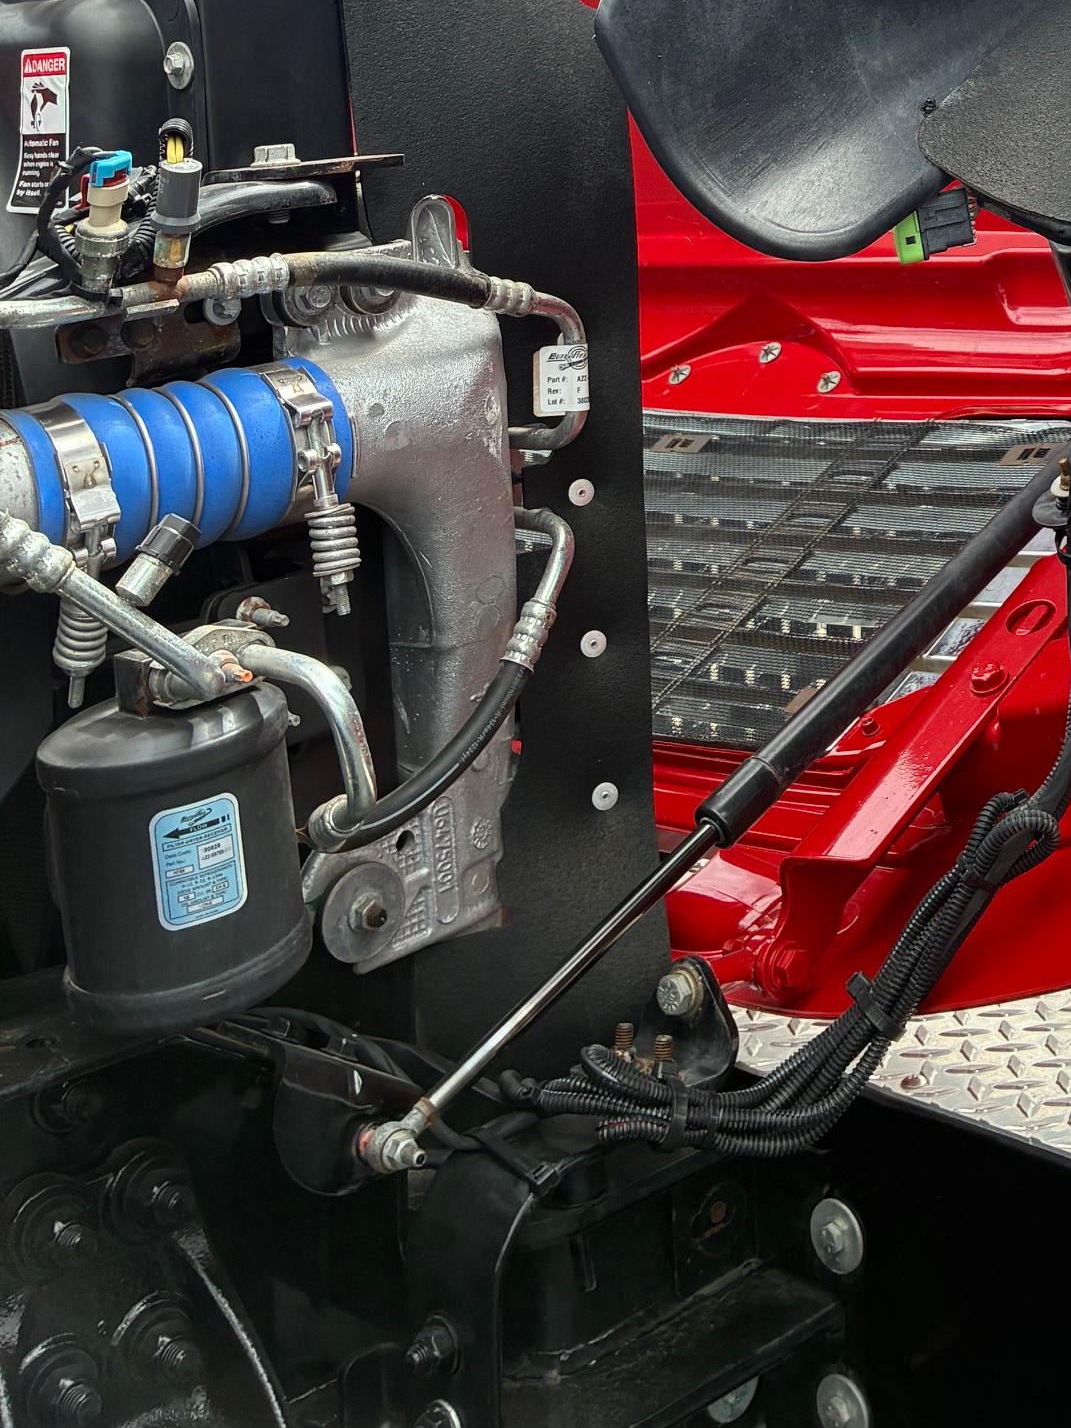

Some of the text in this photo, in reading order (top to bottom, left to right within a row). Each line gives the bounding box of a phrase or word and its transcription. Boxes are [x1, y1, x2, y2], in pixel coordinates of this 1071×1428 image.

[31, 57, 66, 72] DANGER
[49, 138, 59, 147] Fan
[19, 180, 30, 188] Fan
[16, 189, 25, 197] by
[547, 387, 561, 395] Rev:
[547, 398, 557, 406] Lot
[189, 823, 209, 833] FLOW
